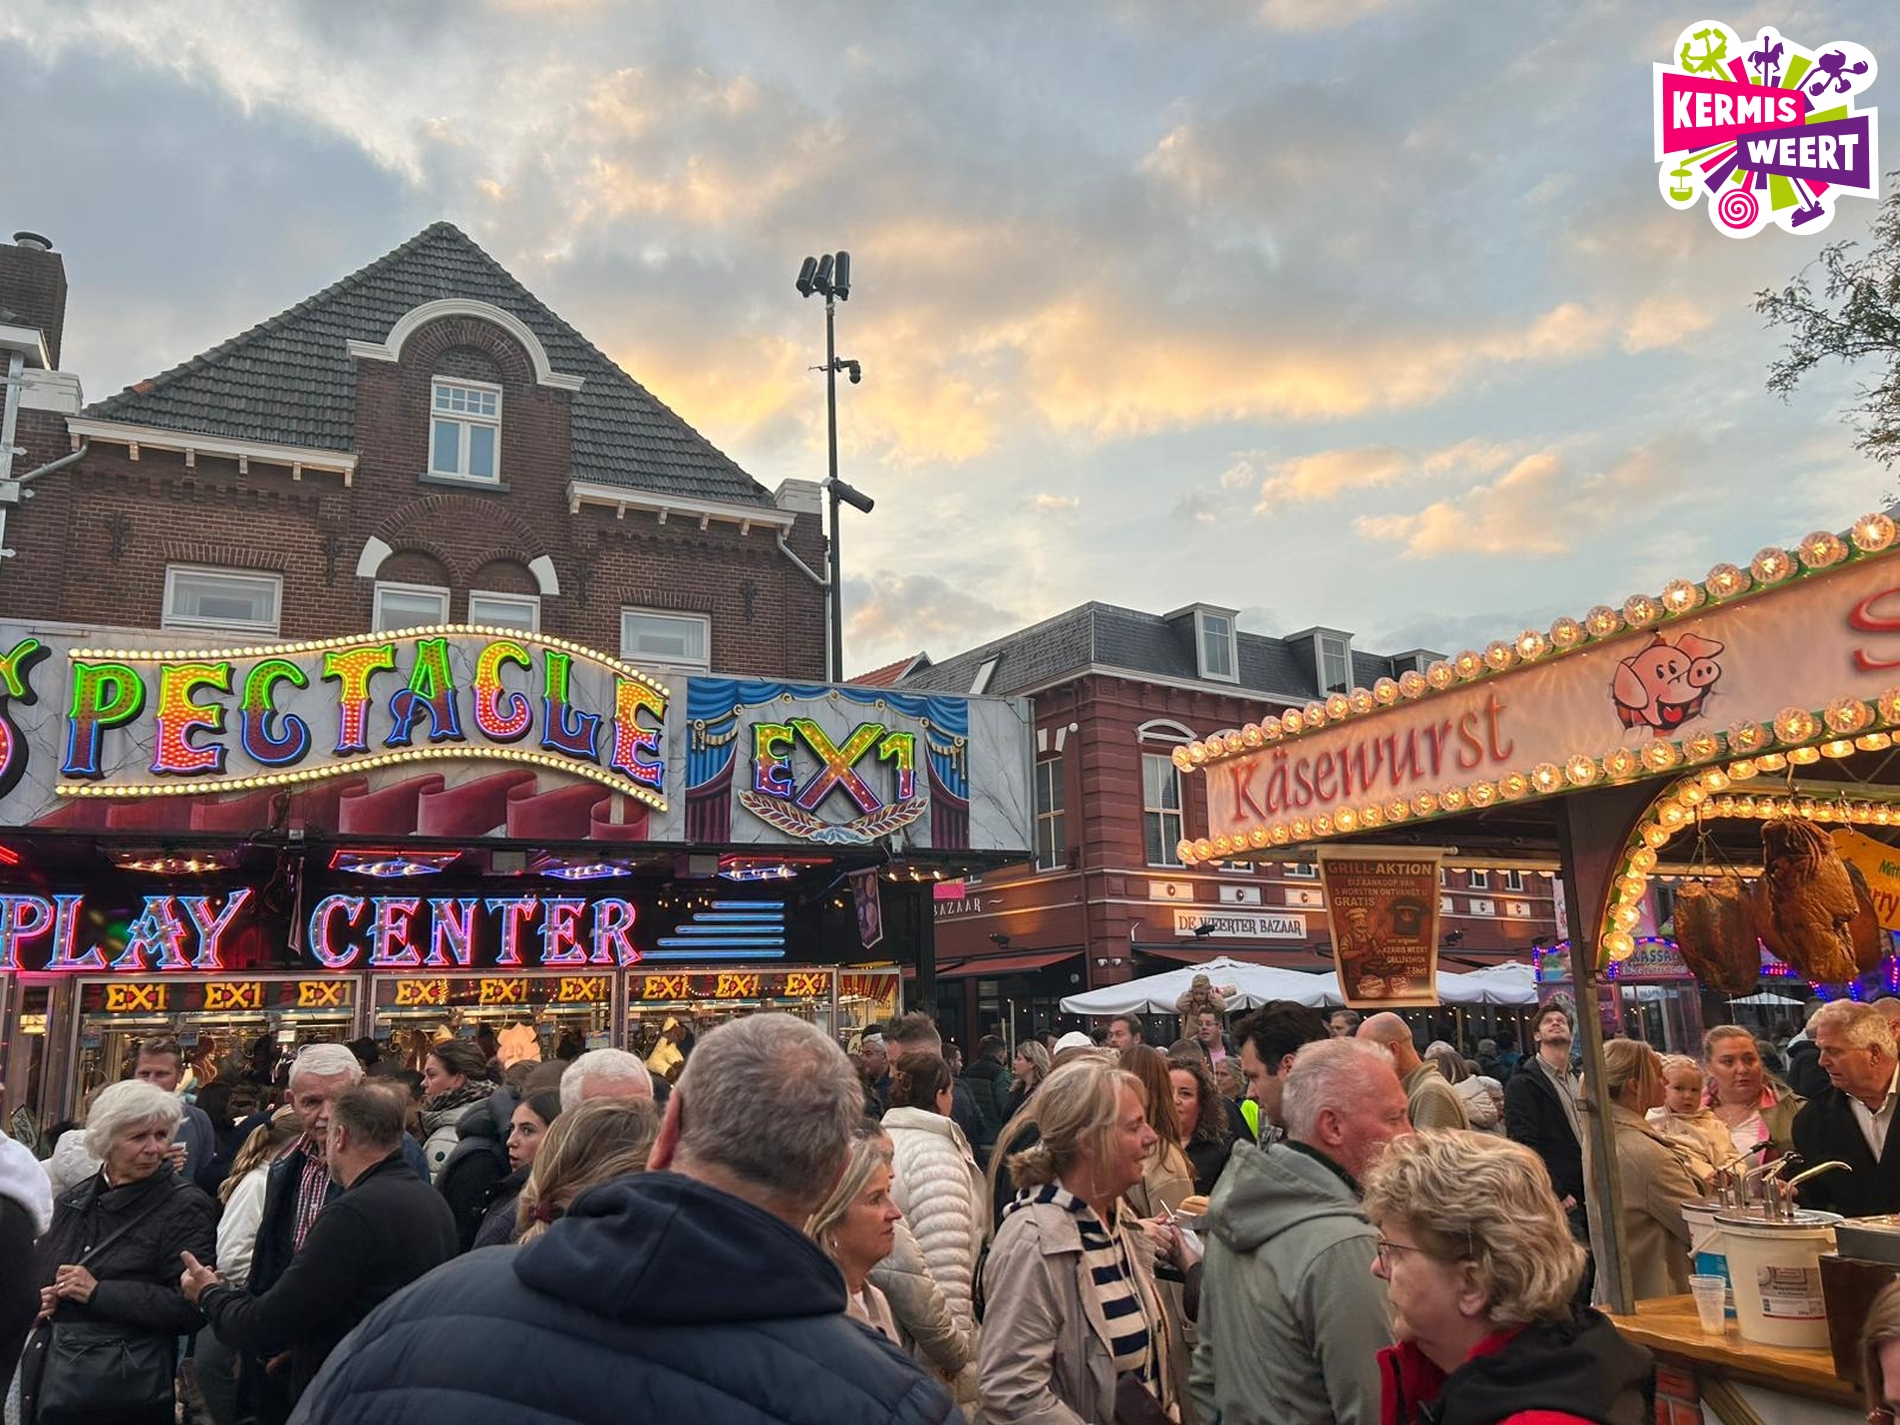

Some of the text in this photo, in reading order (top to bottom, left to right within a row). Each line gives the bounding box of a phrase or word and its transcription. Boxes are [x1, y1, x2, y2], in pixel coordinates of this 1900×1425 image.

[0, 637, 670, 796] PECTACLE
[752, 717, 915, 814] EX1
[1230, 693, 1514, 822] Käsewurst
[1334, 897, 1376, 907] GRATIS
[0, 889, 642, 970] PLAY CENTER
[1179, 916, 1197, 930] DE
[1259, 919, 1303, 936] BAZAAR
[106, 983, 168, 1011] EX1
[204, 982, 262, 1010] EX1
[297, 981, 352, 1008] EX1
[479, 978, 530, 1004] EX1
[559, 977, 607, 1003] EX1
[643, 975, 689, 999] EX1
[715, 974, 760, 998] EX1
[785, 972, 827, 996] EX1
